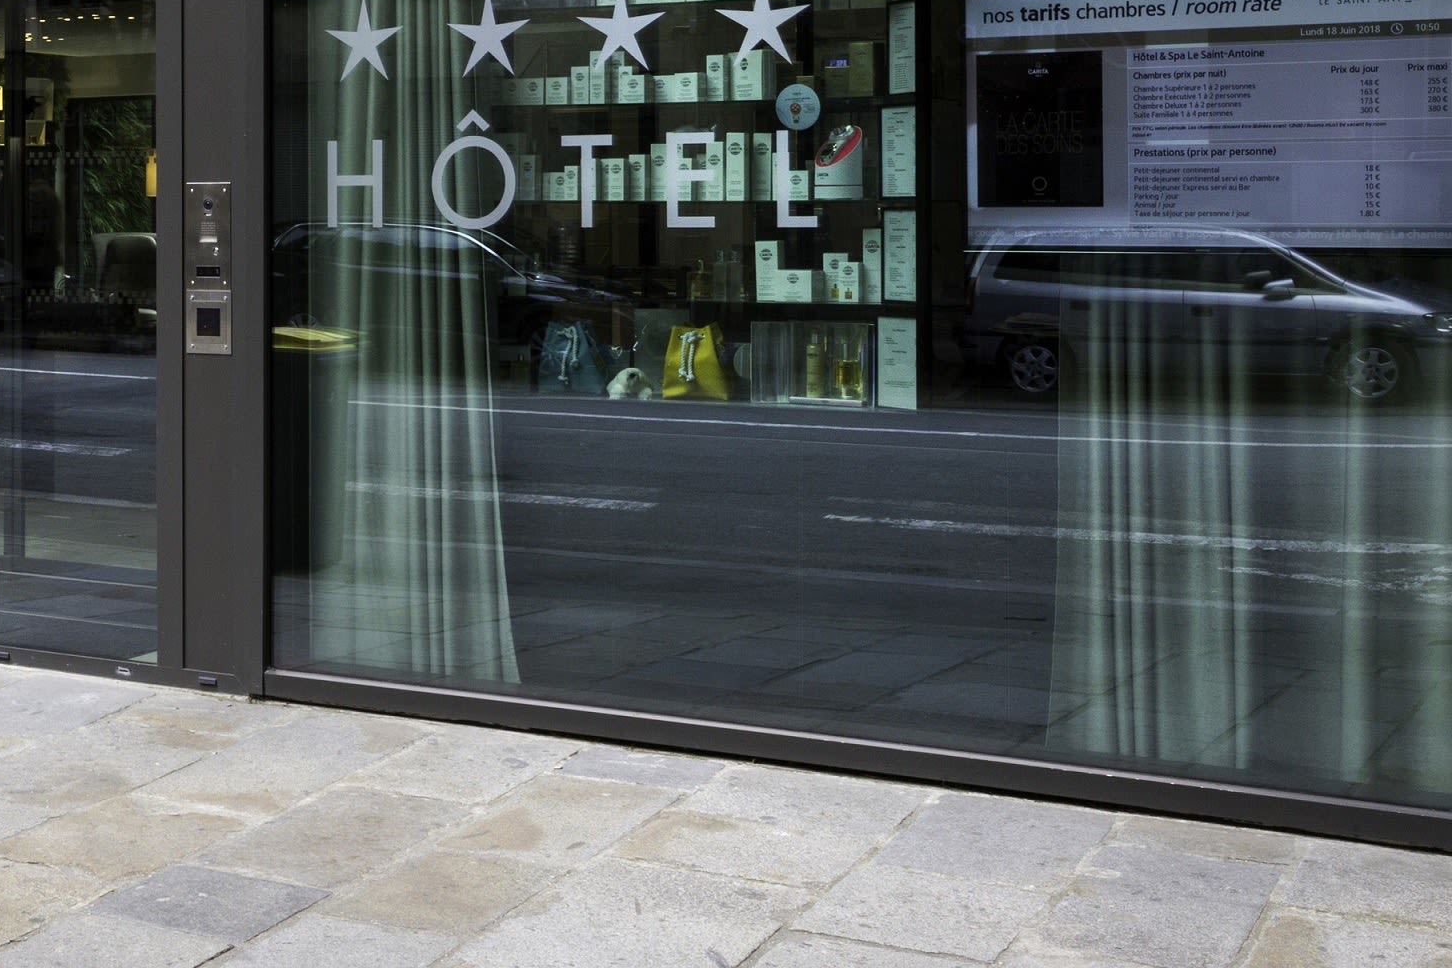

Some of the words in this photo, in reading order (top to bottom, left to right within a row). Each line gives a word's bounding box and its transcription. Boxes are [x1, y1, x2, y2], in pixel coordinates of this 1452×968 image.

[983, 10, 1014, 24] nos
[1020, 3, 1070, 22] tarifs
[1076, 0, 1166, 19] chambres
[1171, 0, 1179, 16] /
[1185, 0, 1237, 15] room
[1300, 27, 1324, 36] Lundi
[1328, 27, 1337, 36] 18
[1338, 26, 1358, 36] Juin
[1360, 25, 1381, 34] 2018
[1133, 51, 1158, 62] Hôtel
[1160, 52, 1166, 60] &
[1168, 51, 1185, 62] Spa
[1188, 51, 1198, 60] Le
[1201, 49, 1265, 59] Saint-Antoine
[1331, 66, 1347, 74] Prix
[1362, 65, 1380, 74] jour
[1408, 64, 1424, 72] Prix
[1427, 62, 1448, 70] maxi
[1132, 71, 1171, 80] Chambres
[1173, 70, 1191, 81] (prix
[1193, 71, 1205, 80] par
[1208, 70, 1227, 79] nuit)
[1134, 148, 1185, 158] Prestations
[1187, 148, 1208, 159] (prix
[1211, 149, 1226, 158] par
[1229, 146, 1277, 158] personne)
[326, 108, 818, 230] HÔTEL
[1294, 228, 1334, 241] Johnny
